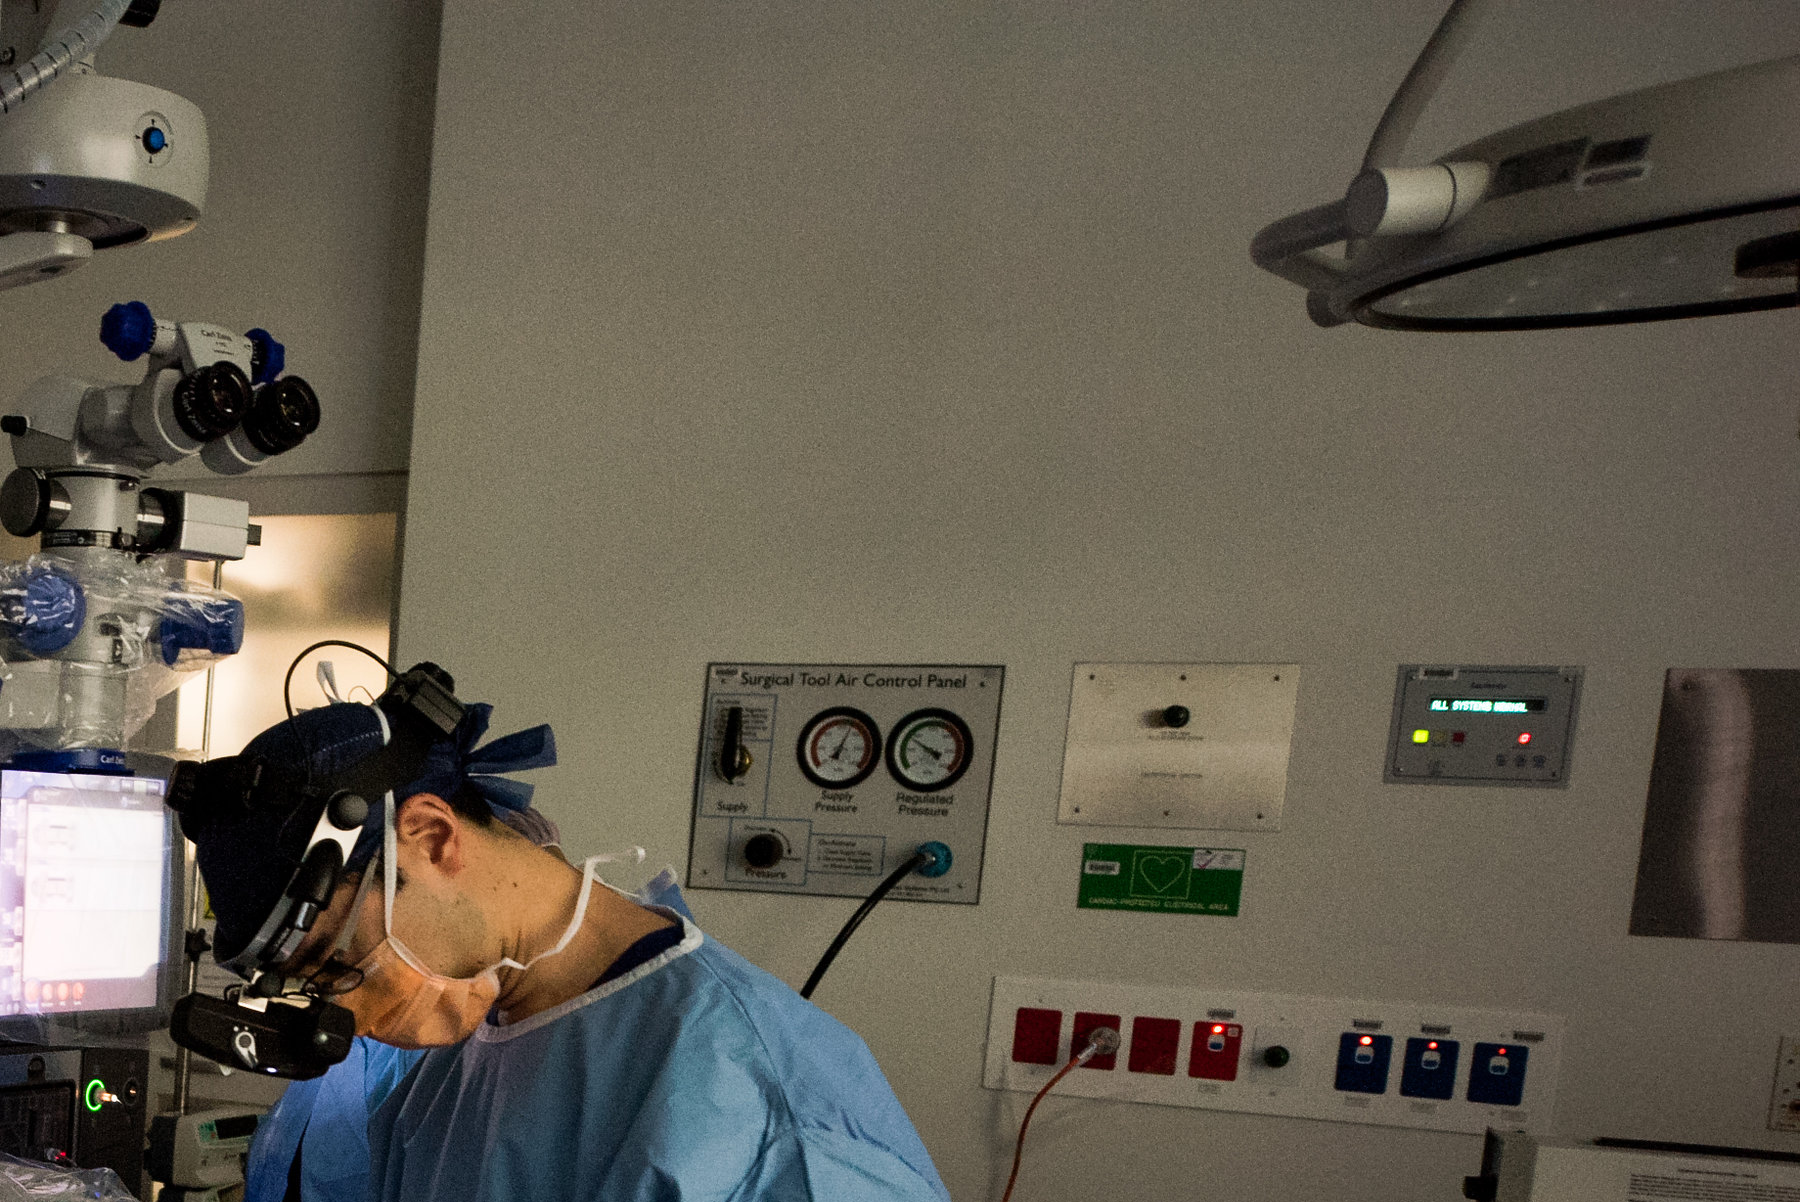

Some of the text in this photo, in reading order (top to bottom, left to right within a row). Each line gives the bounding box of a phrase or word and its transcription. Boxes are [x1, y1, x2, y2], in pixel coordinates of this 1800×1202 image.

[741, 671, 794, 689] Surgical
[799, 673, 833, 687] Tool
[835, 674, 858, 687] Air
[863, 673, 922, 688] Control
[927, 674, 967, 688] Panel
[1431, 700, 1448, 711] ALL
[1451, 700, 1492, 712] SYSTEMS
[821, 791, 853, 801] Supply
[896, 792, 954, 805] Regulated
[717, 801, 749, 813] Supply
[815, 803, 858, 813] Pressure
[898, 805, 949, 817] Pressure
[745, 868, 787, 880] Pressure
